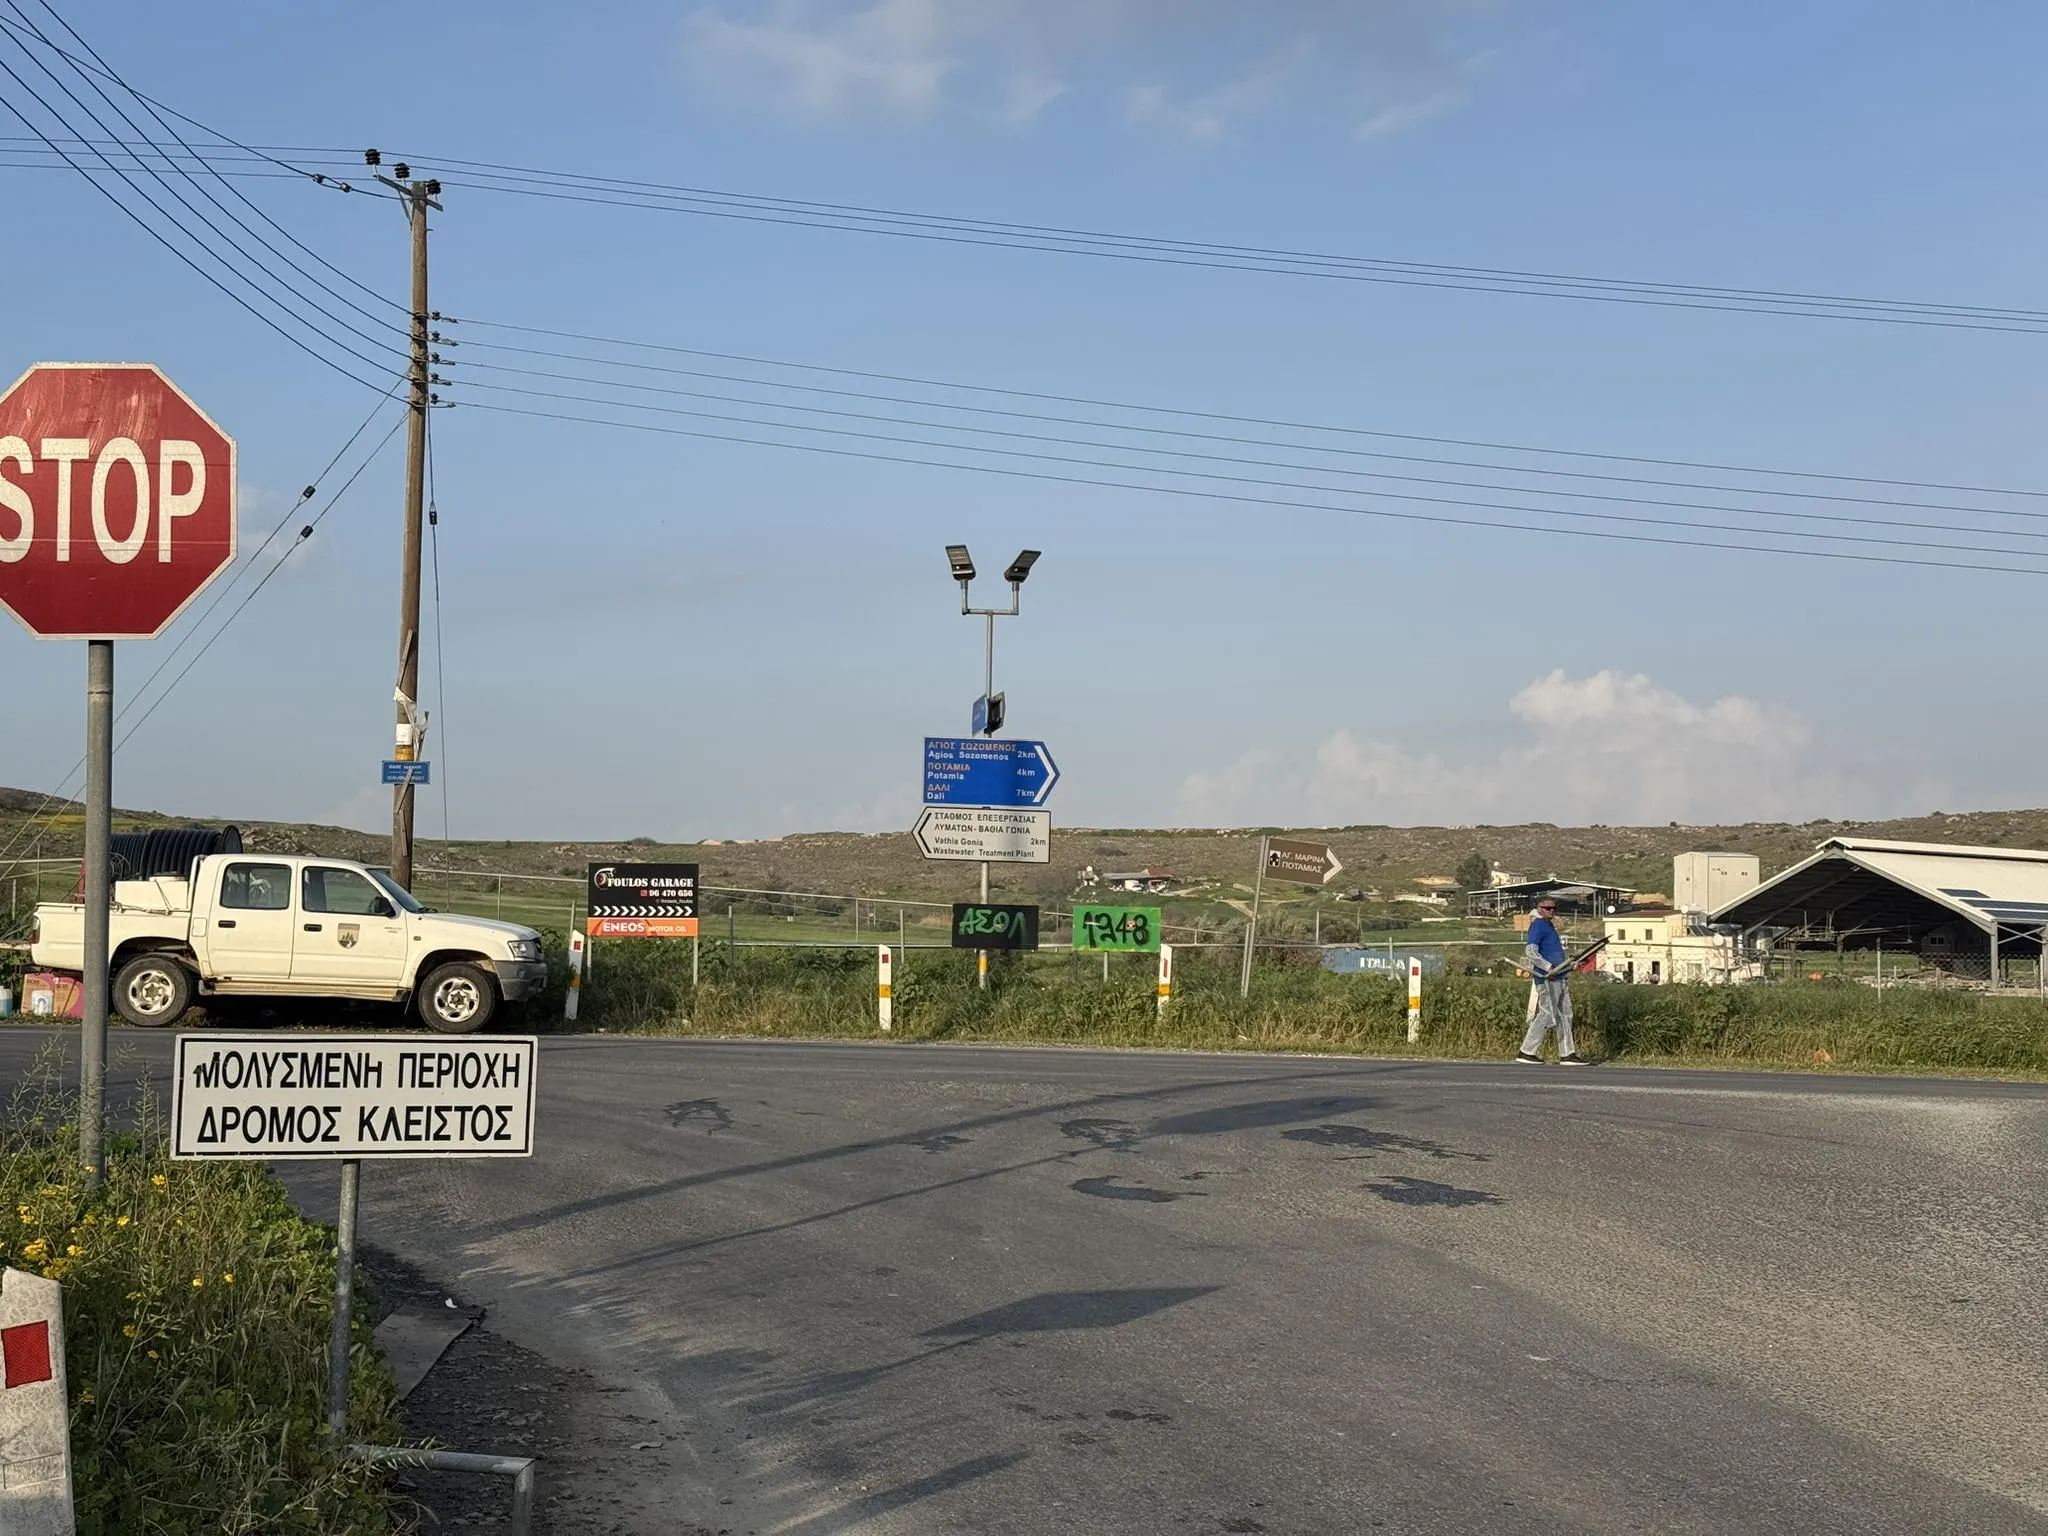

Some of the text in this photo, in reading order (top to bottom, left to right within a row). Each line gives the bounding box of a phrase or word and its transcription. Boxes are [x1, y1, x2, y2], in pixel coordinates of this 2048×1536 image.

[0, 435, 206, 564] STOP
[928, 742, 1017, 752] ΑΓΙΟΣ ΣΩΖΟΜΕΝΟΣ
[928, 750, 1009, 761] Agios Sozomenos
[1017, 750, 1036, 759] 2km
[928, 762, 971, 772] ΠΟΤΑΜΙΑ
[927, 772, 965, 780] Potamia
[1016, 768, 1036, 777] 4km
[928, 784, 950, 792] ΔΑΛΙ
[1016, 789, 1035, 797] 7km
[927, 792, 945, 800] Dali
[934, 812, 1037, 824] ΣΤΑΘΜΟΣ ΕΠΕΞΕΡΓΑΣΙΑΣ
[979, 825, 1004, 834] ΒΑΘΙΑ
[1006, 826, 1031, 835] ΓΩΝΙΑ
[934, 837, 984, 846] Vathia Gonia
[1030, 838, 1046, 846] 2km
[933, 847, 1035, 858] Wastewater Treatment Plant
[1294, 853, 1326, 865] ΜΑΡΙΝΑ
[1281, 861, 1323, 874] ΠΟΤΑΜΙΑΣ
[651, 878, 694, 888] GARAGE
[603, 922, 645, 933] ENEOS
[647, 925, 675, 933] MOTOR
[1082, 911, 1151, 948] 1948
[193, 1051, 521, 1089] ΜΟΛΥΣΜΕΝΗ ΠΕΡΙΟΧΗ
[197, 1105, 513, 1144] ΔΡΟΜΟΣ ΚΛΕΙΣΤΟΣ
